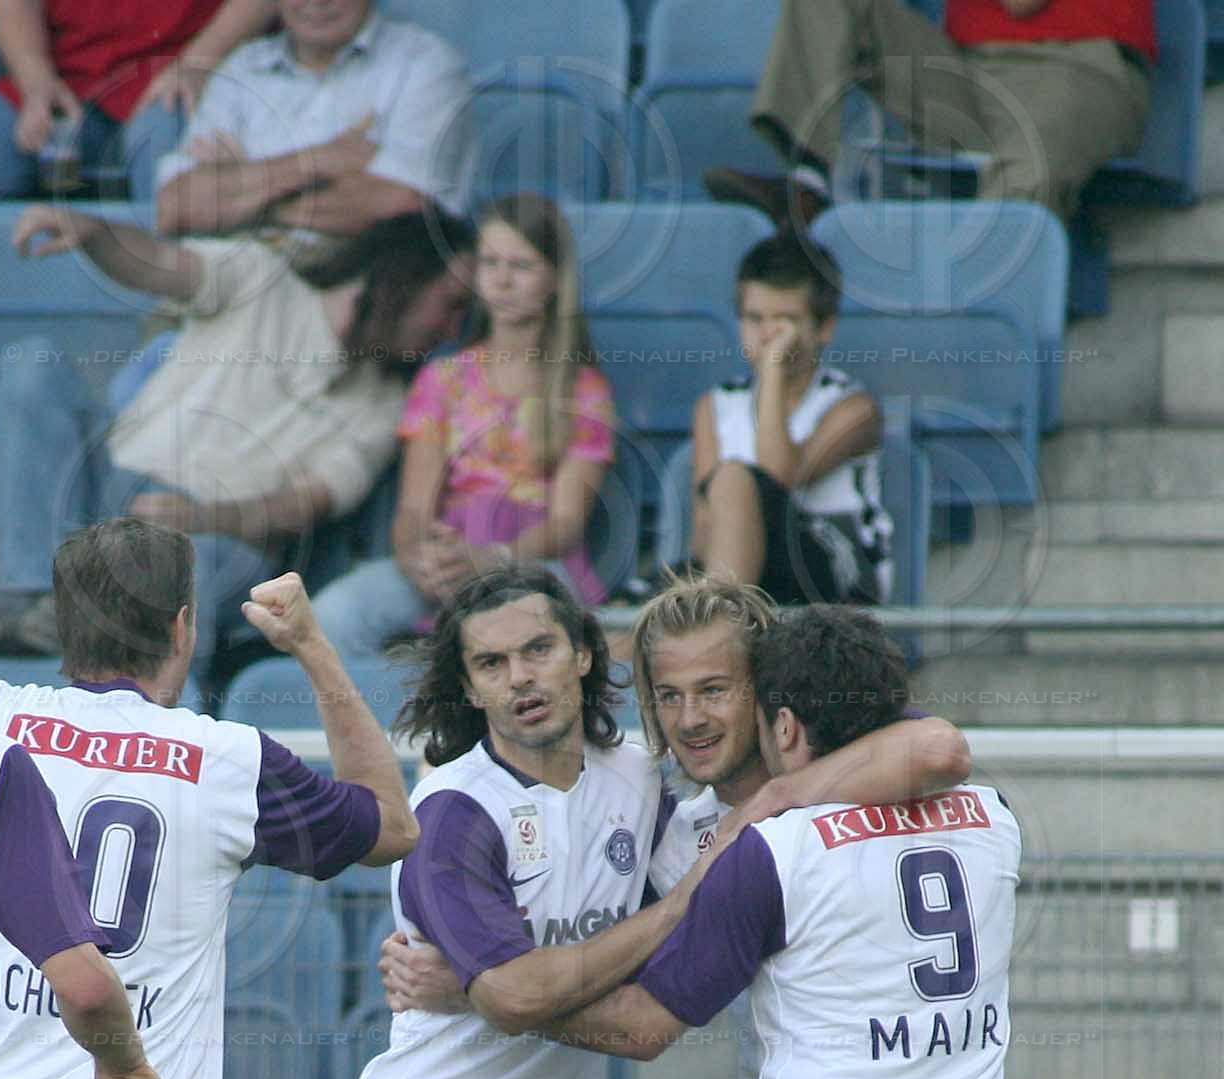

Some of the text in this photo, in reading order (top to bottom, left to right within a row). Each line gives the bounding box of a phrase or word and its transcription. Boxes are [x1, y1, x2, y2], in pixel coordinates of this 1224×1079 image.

[15, 718, 193, 776] KURIER
[823, 794, 985, 842] KURIER
[895, 845, 980, 1002] 9
[869, 1003, 1003, 1061] MAIR
